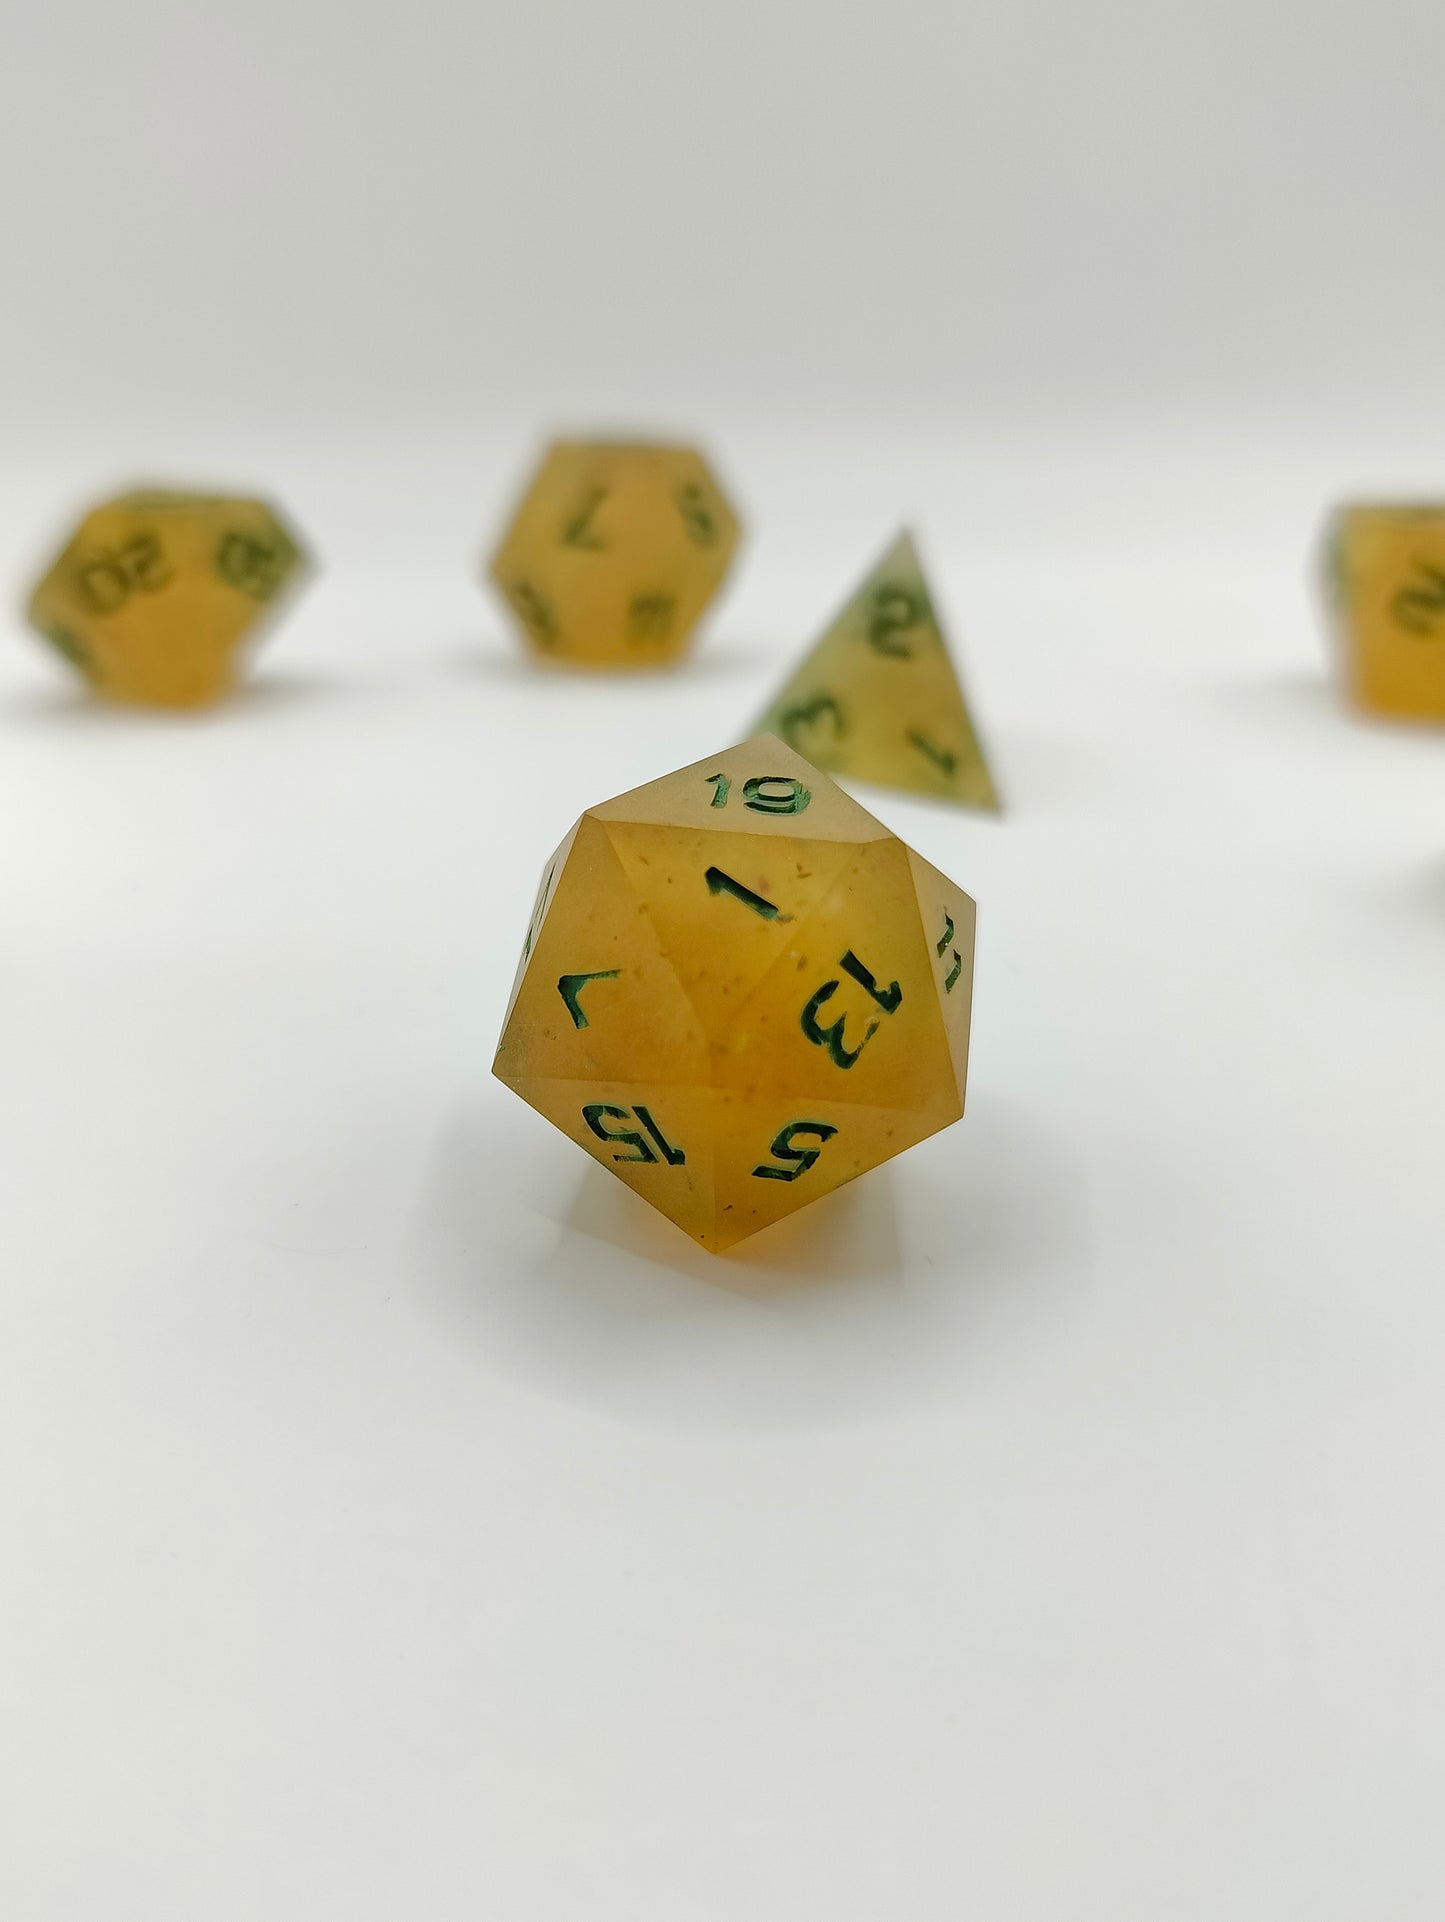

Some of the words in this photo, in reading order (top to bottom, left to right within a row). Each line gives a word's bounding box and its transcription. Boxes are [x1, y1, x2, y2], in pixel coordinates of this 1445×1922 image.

[705, 773, 811, 815] 19
[705, 866, 788, 922] 1
[557, 969, 621, 1029] 7
[801, 949, 902, 1069] 13
[581, 1103, 686, 1166] 15
[752, 1119, 838, 1182] 5
